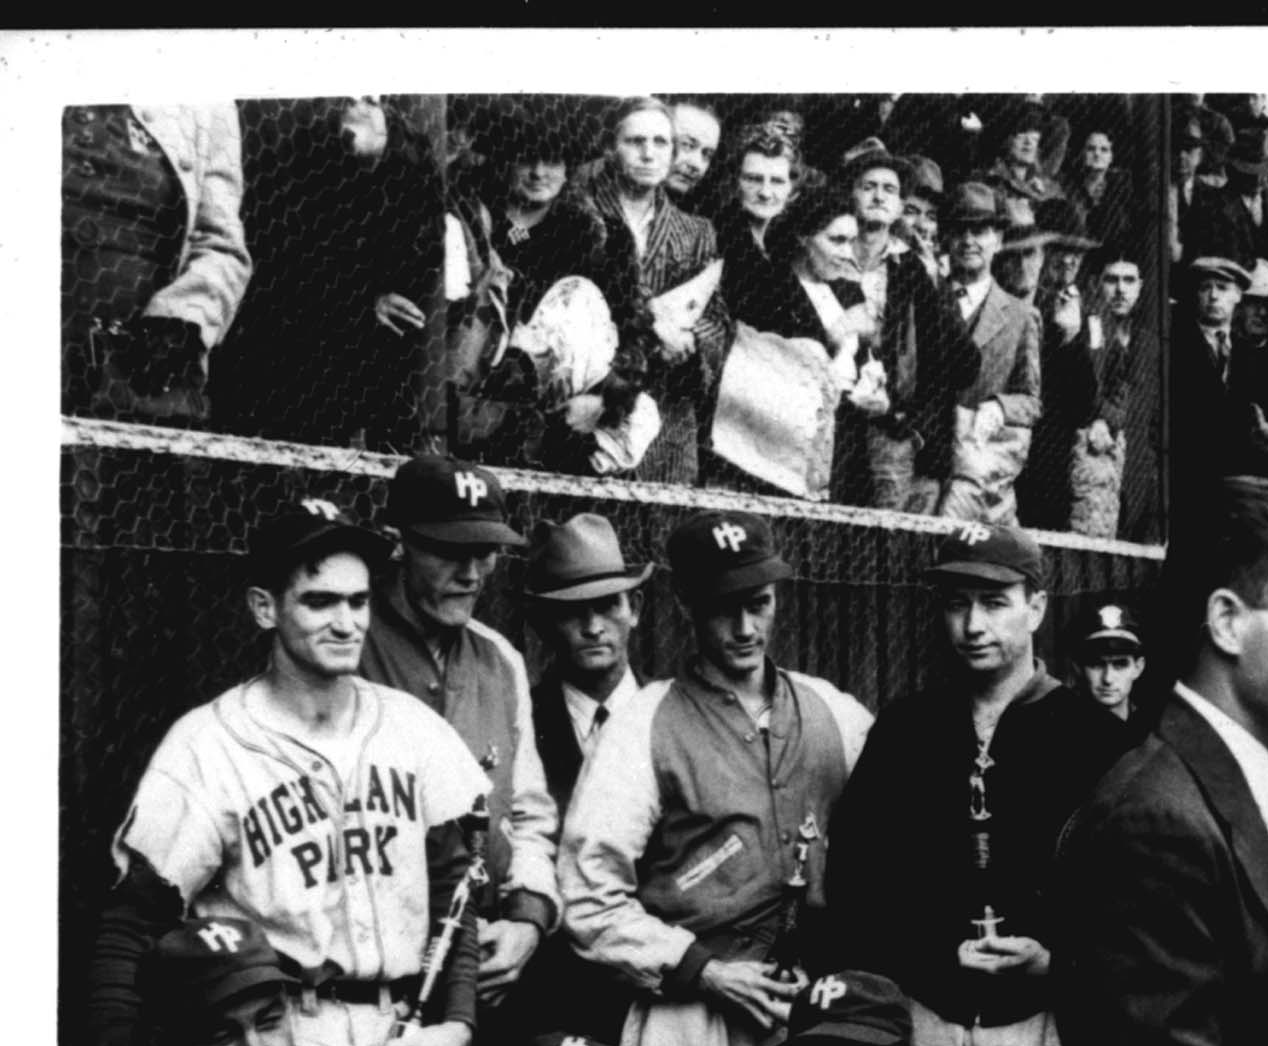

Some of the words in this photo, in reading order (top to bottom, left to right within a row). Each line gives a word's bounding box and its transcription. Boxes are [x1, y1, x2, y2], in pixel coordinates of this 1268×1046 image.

[455, 471, 488, 507] HP
[712, 522, 747, 552] HP
[809, 974, 847, 1010] HP
